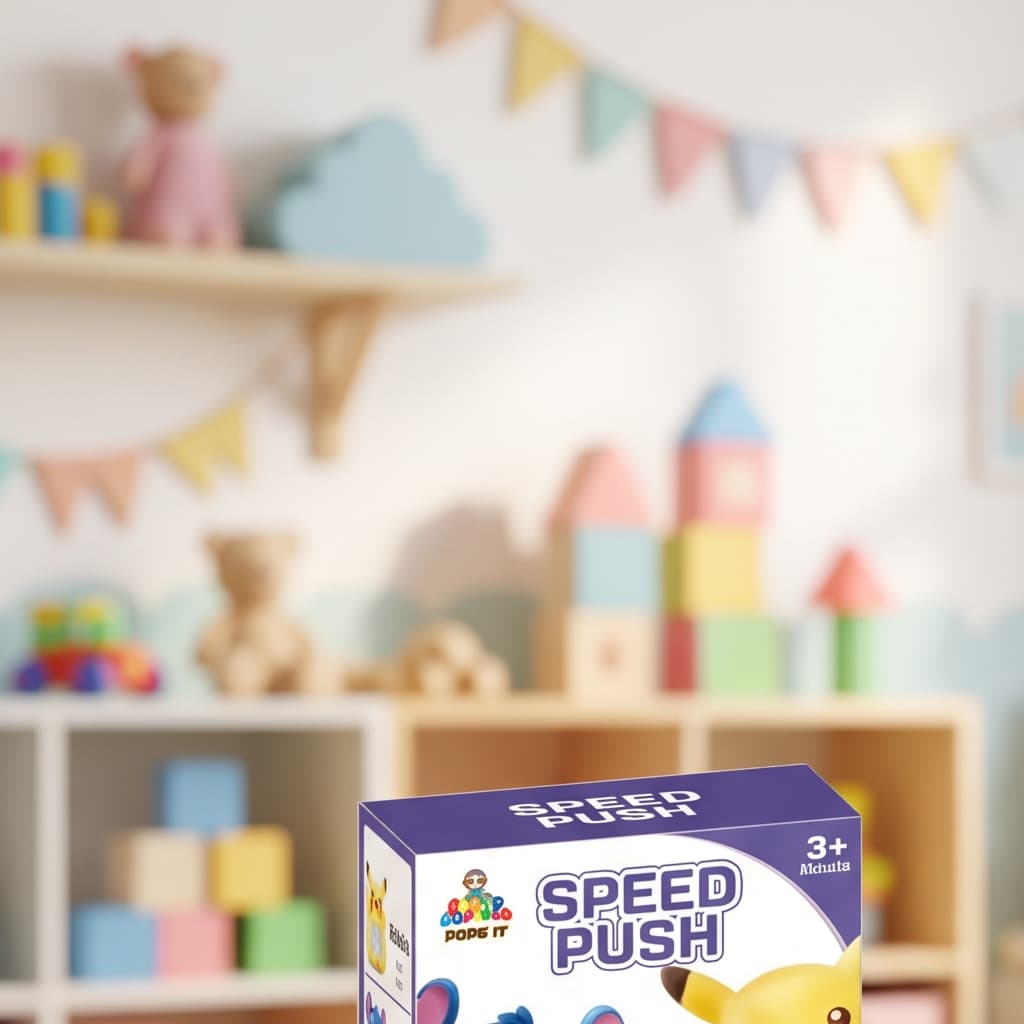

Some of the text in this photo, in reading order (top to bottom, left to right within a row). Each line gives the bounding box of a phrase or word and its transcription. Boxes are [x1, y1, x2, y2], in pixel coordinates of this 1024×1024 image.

[508, 790, 701, 816] SPEED
[537, 804, 697, 829] PUSH
[806, 835, 848, 860] 3+
[538, 862, 740, 923] SPEED
[492, 925, 509, 938] IT
[552, 908, 721, 972] PUSH
